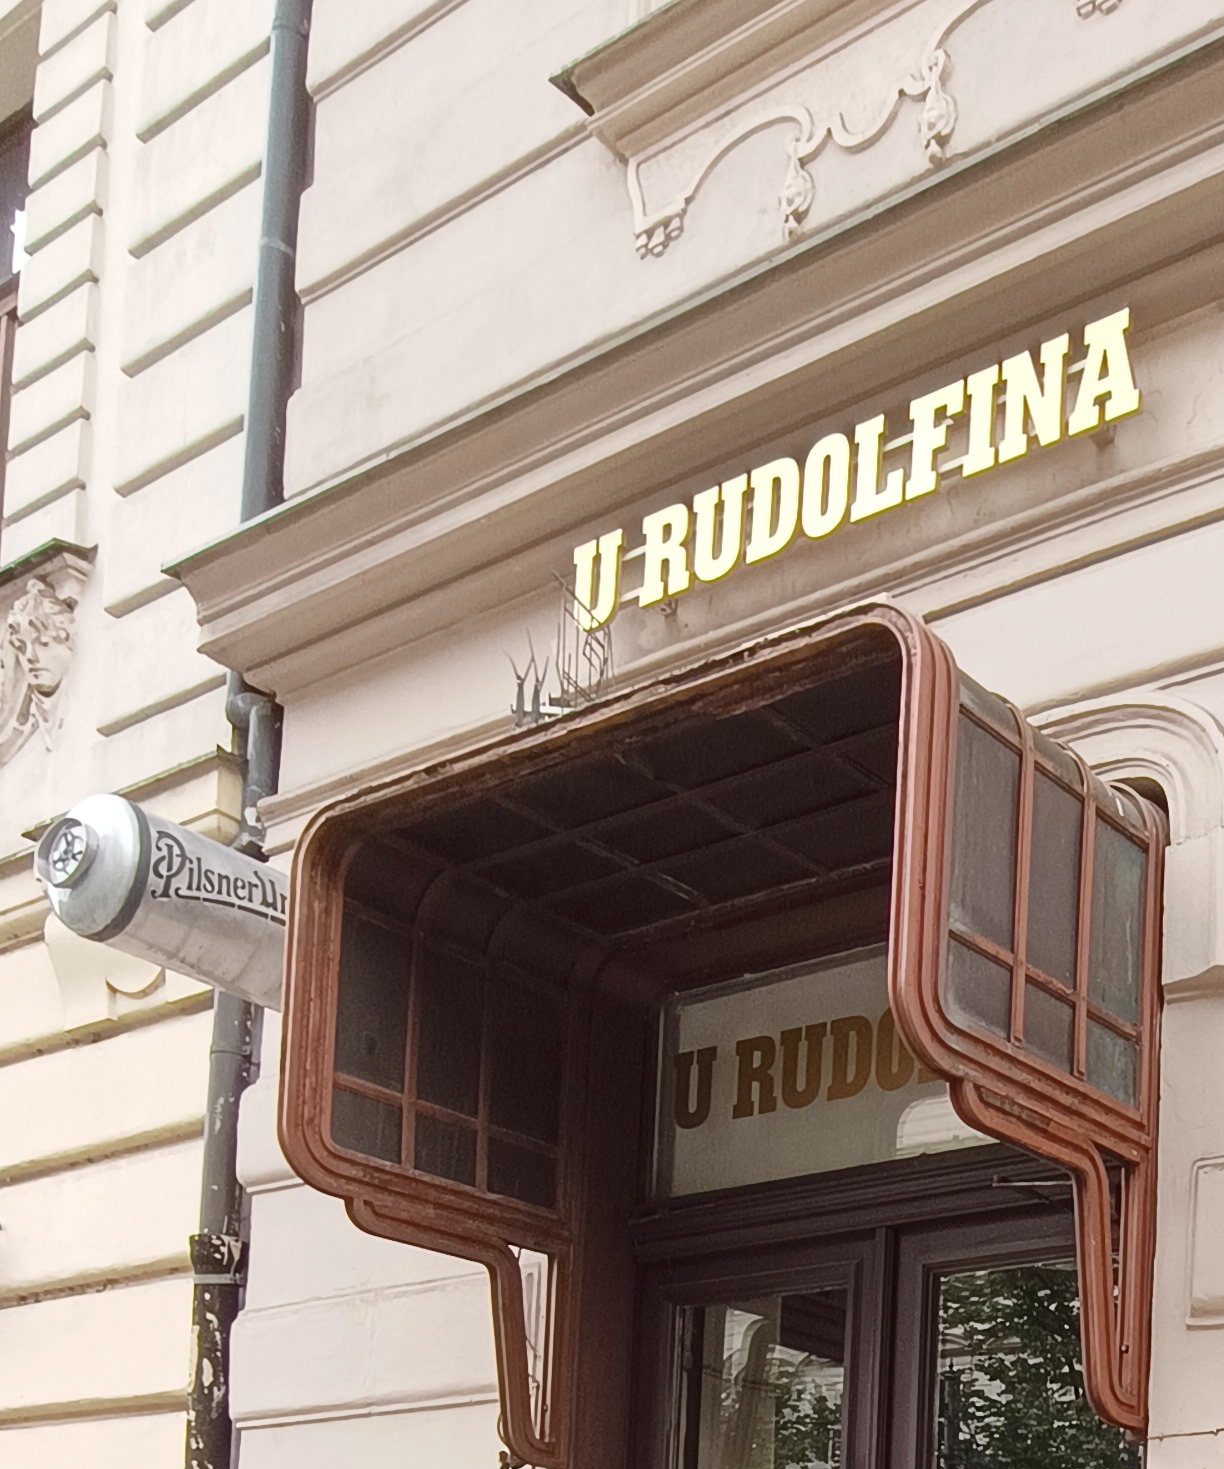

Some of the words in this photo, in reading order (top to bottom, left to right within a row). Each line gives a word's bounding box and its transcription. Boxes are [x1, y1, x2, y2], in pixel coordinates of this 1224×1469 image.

[573, 528, 622, 631] U
[638, 307, 1139, 608] RUDOLFINA
[151, 830, 258, 900] Pilsner
[674, 1046, 717, 1129] U
